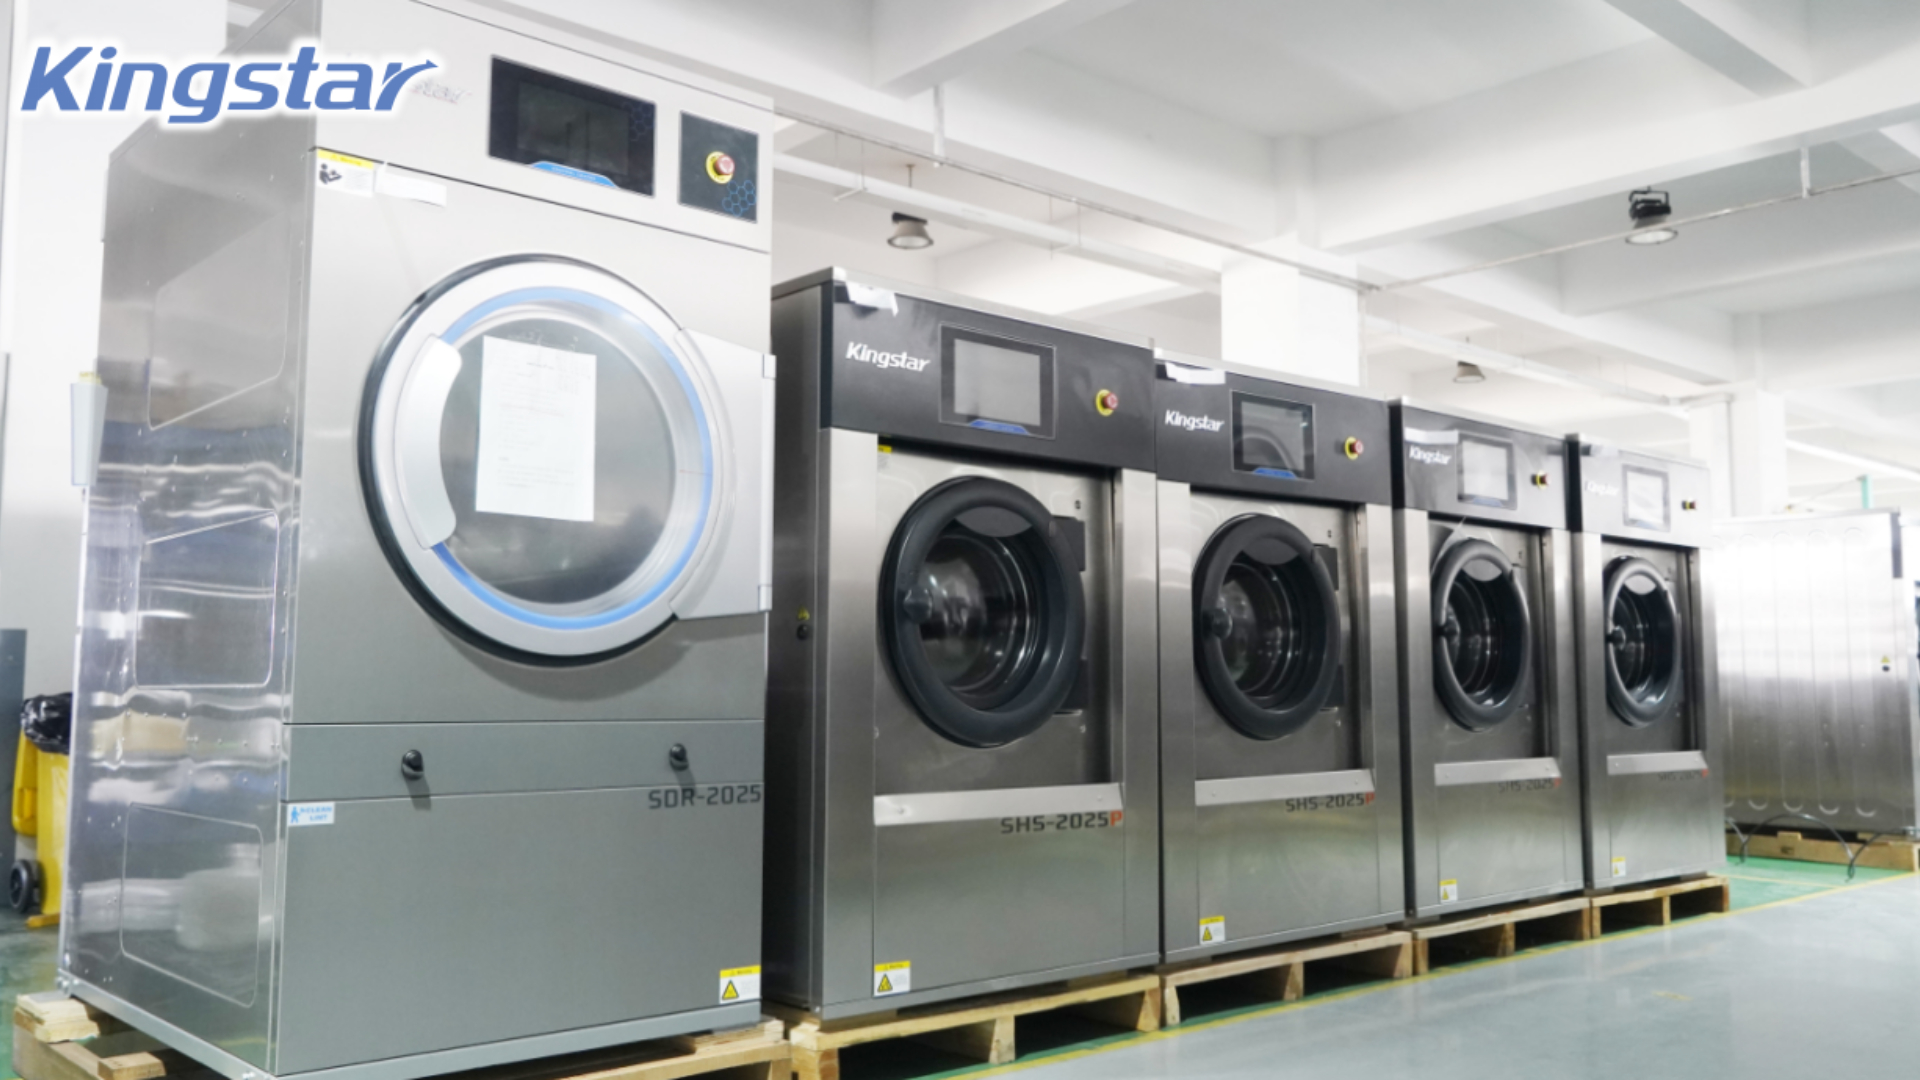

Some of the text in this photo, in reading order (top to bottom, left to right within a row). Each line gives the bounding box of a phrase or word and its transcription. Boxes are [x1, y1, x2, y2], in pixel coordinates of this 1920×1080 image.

[846, 341, 931, 371] Kingstar
[1164, 409, 1225, 432] Kingstar
[648, 784, 762, 810] SDR-2025
[1285, 791, 1375, 813] SHS-2025P
[1000, 810, 1123, 834] SHS-2025P
